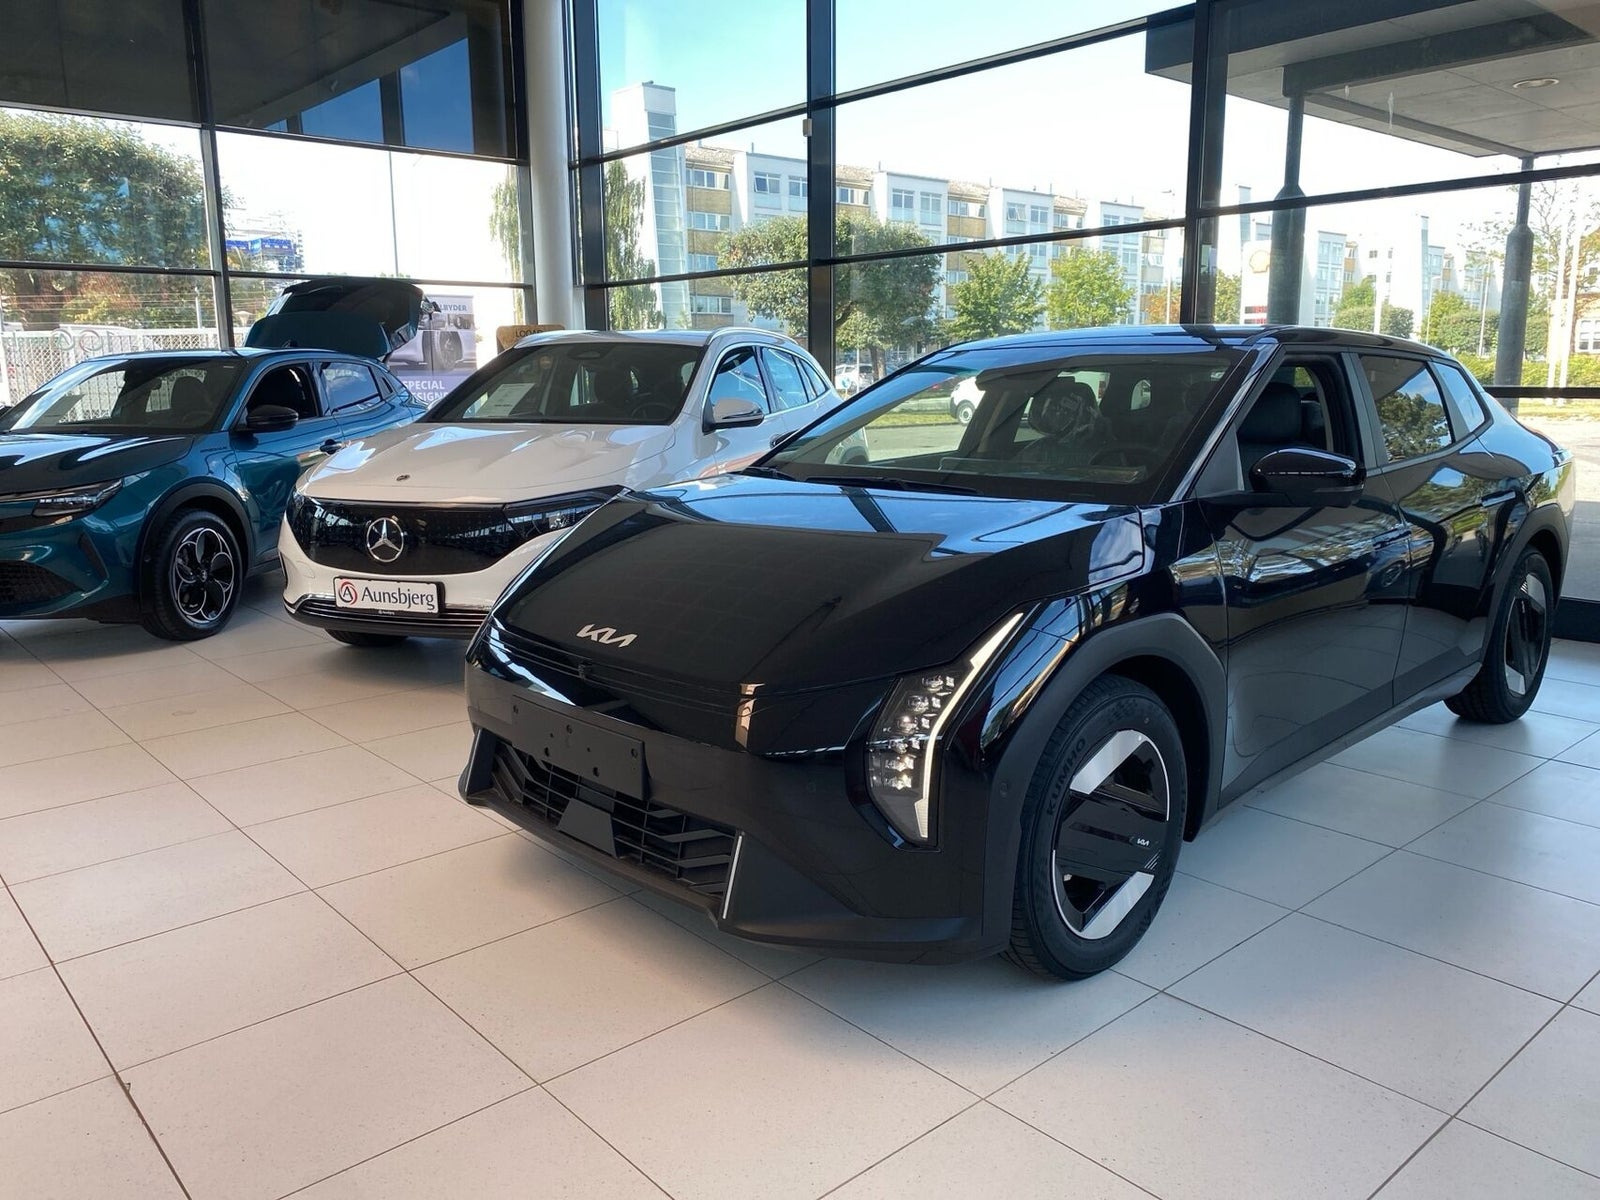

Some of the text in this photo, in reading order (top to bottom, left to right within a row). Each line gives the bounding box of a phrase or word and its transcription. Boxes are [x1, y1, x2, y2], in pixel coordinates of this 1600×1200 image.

[402, 380, 445, 390] SPECIAL
[361, 586, 435, 611] Aunsbjerg
[576, 623, 638, 648] KIA
[1046, 738, 1086, 815] KUMHO
